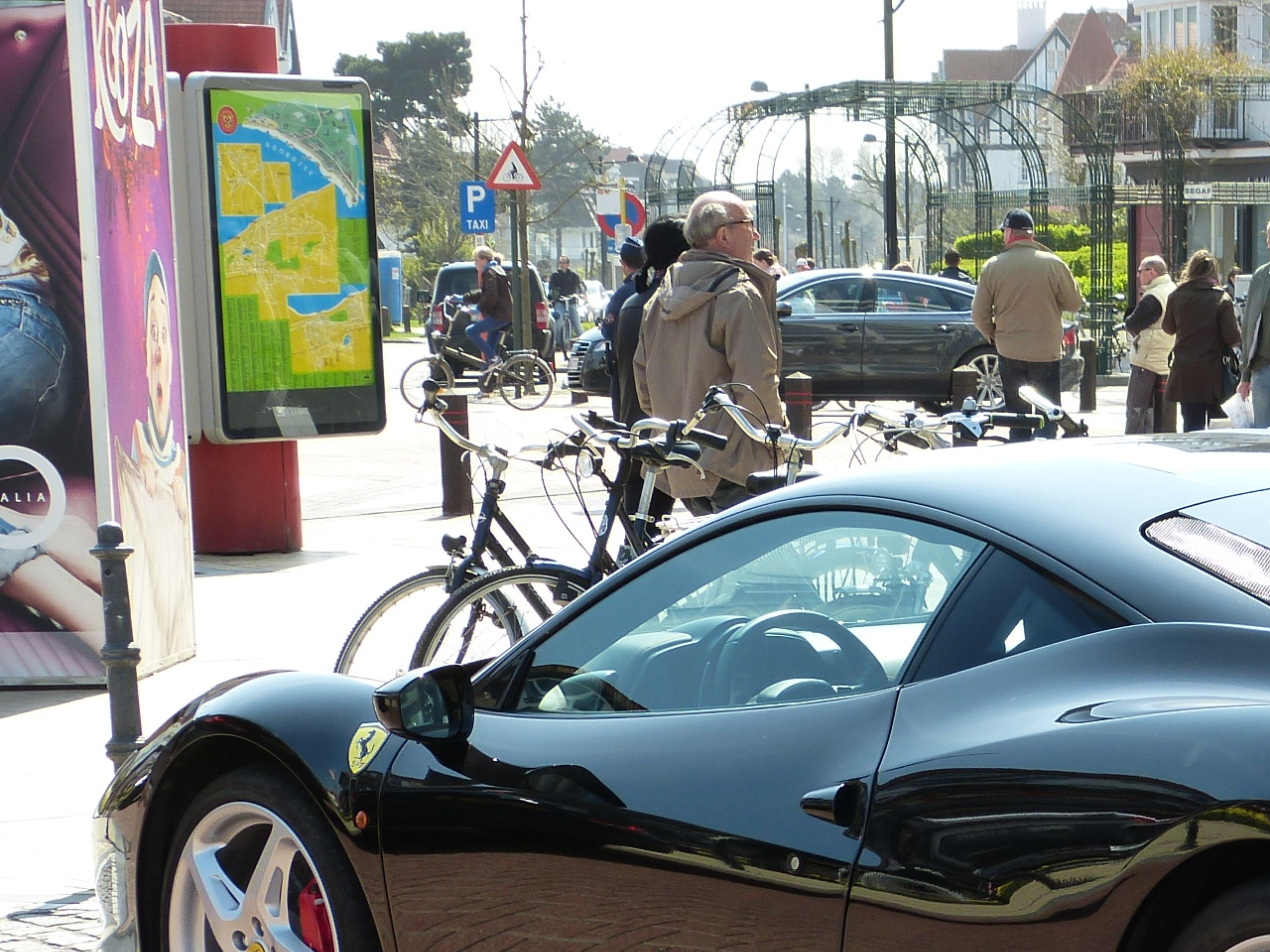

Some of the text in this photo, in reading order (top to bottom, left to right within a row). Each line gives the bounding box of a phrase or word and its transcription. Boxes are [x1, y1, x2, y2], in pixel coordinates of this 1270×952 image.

[87, 0, 162, 148] KOOZA
[467, 185, 486, 213] P
[466, 219, 488, 230] TAXI
